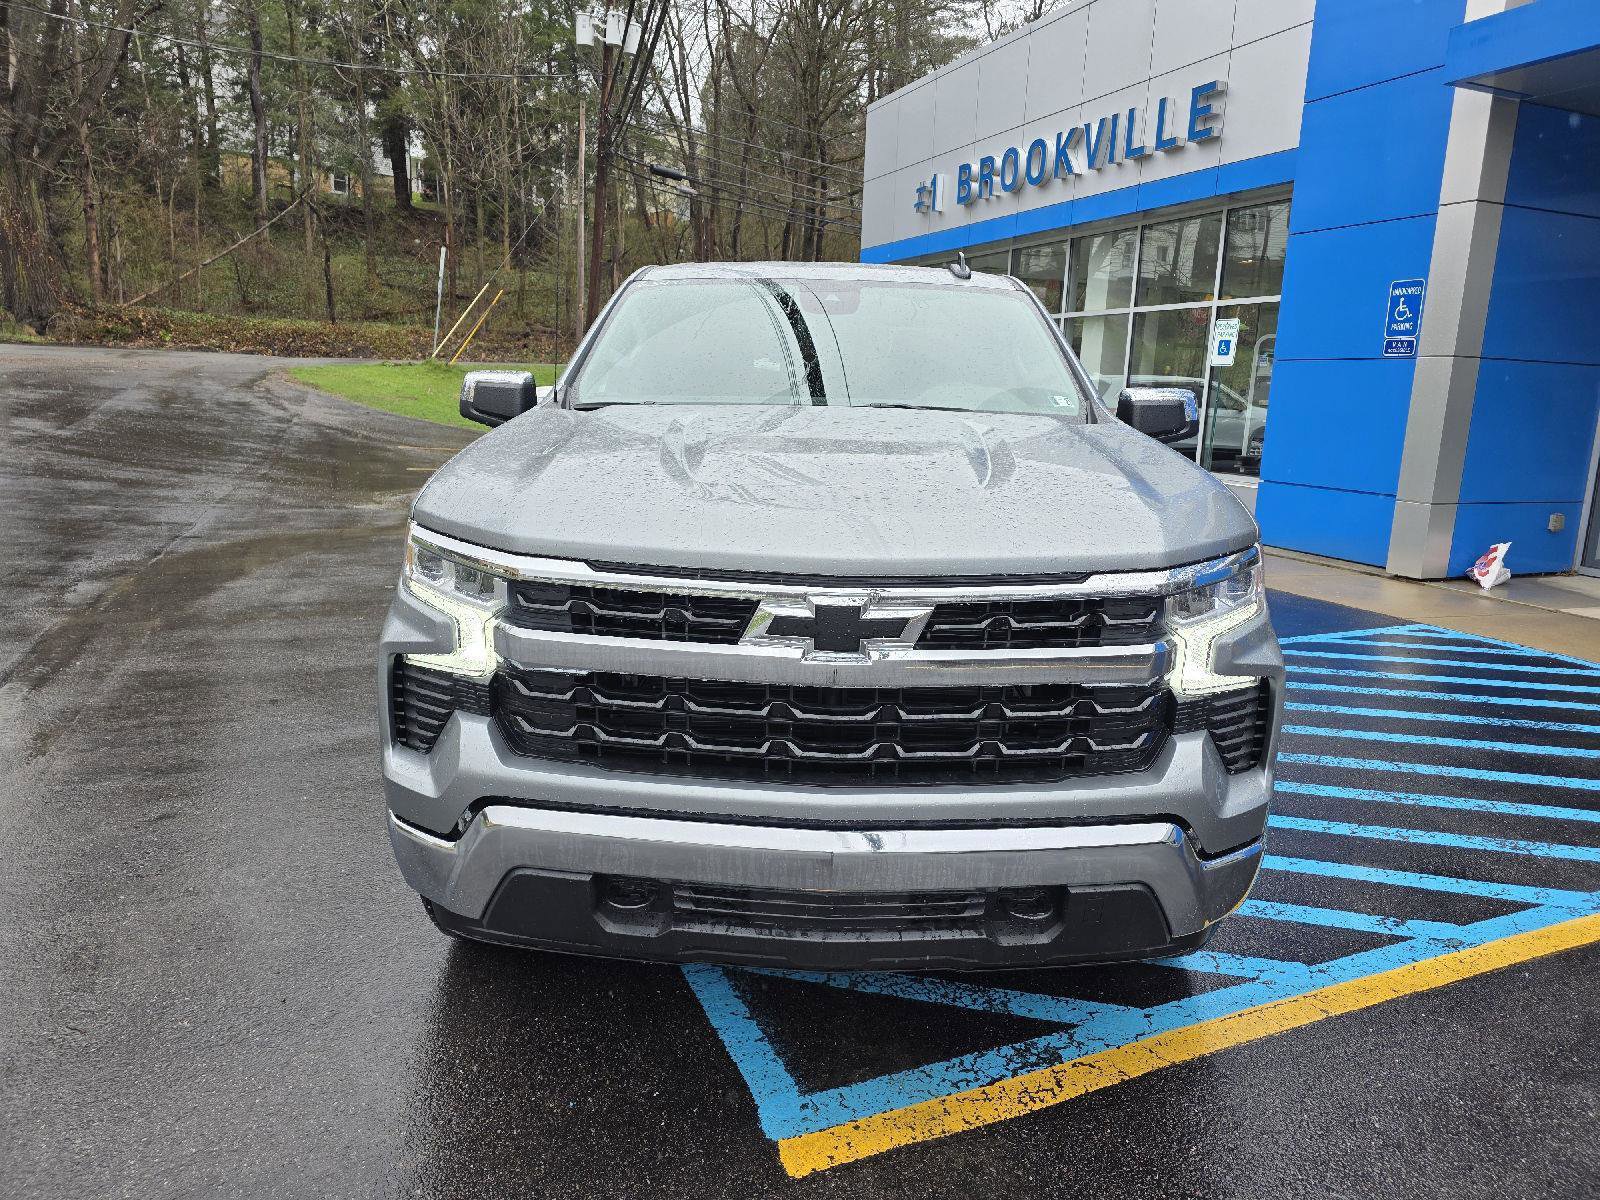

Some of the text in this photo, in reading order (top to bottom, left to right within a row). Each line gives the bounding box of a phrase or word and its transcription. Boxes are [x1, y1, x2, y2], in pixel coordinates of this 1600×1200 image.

[914, 80, 1228, 213] #1 BROOKVILLE
[1391, 322, 1413, 331] PARKING
